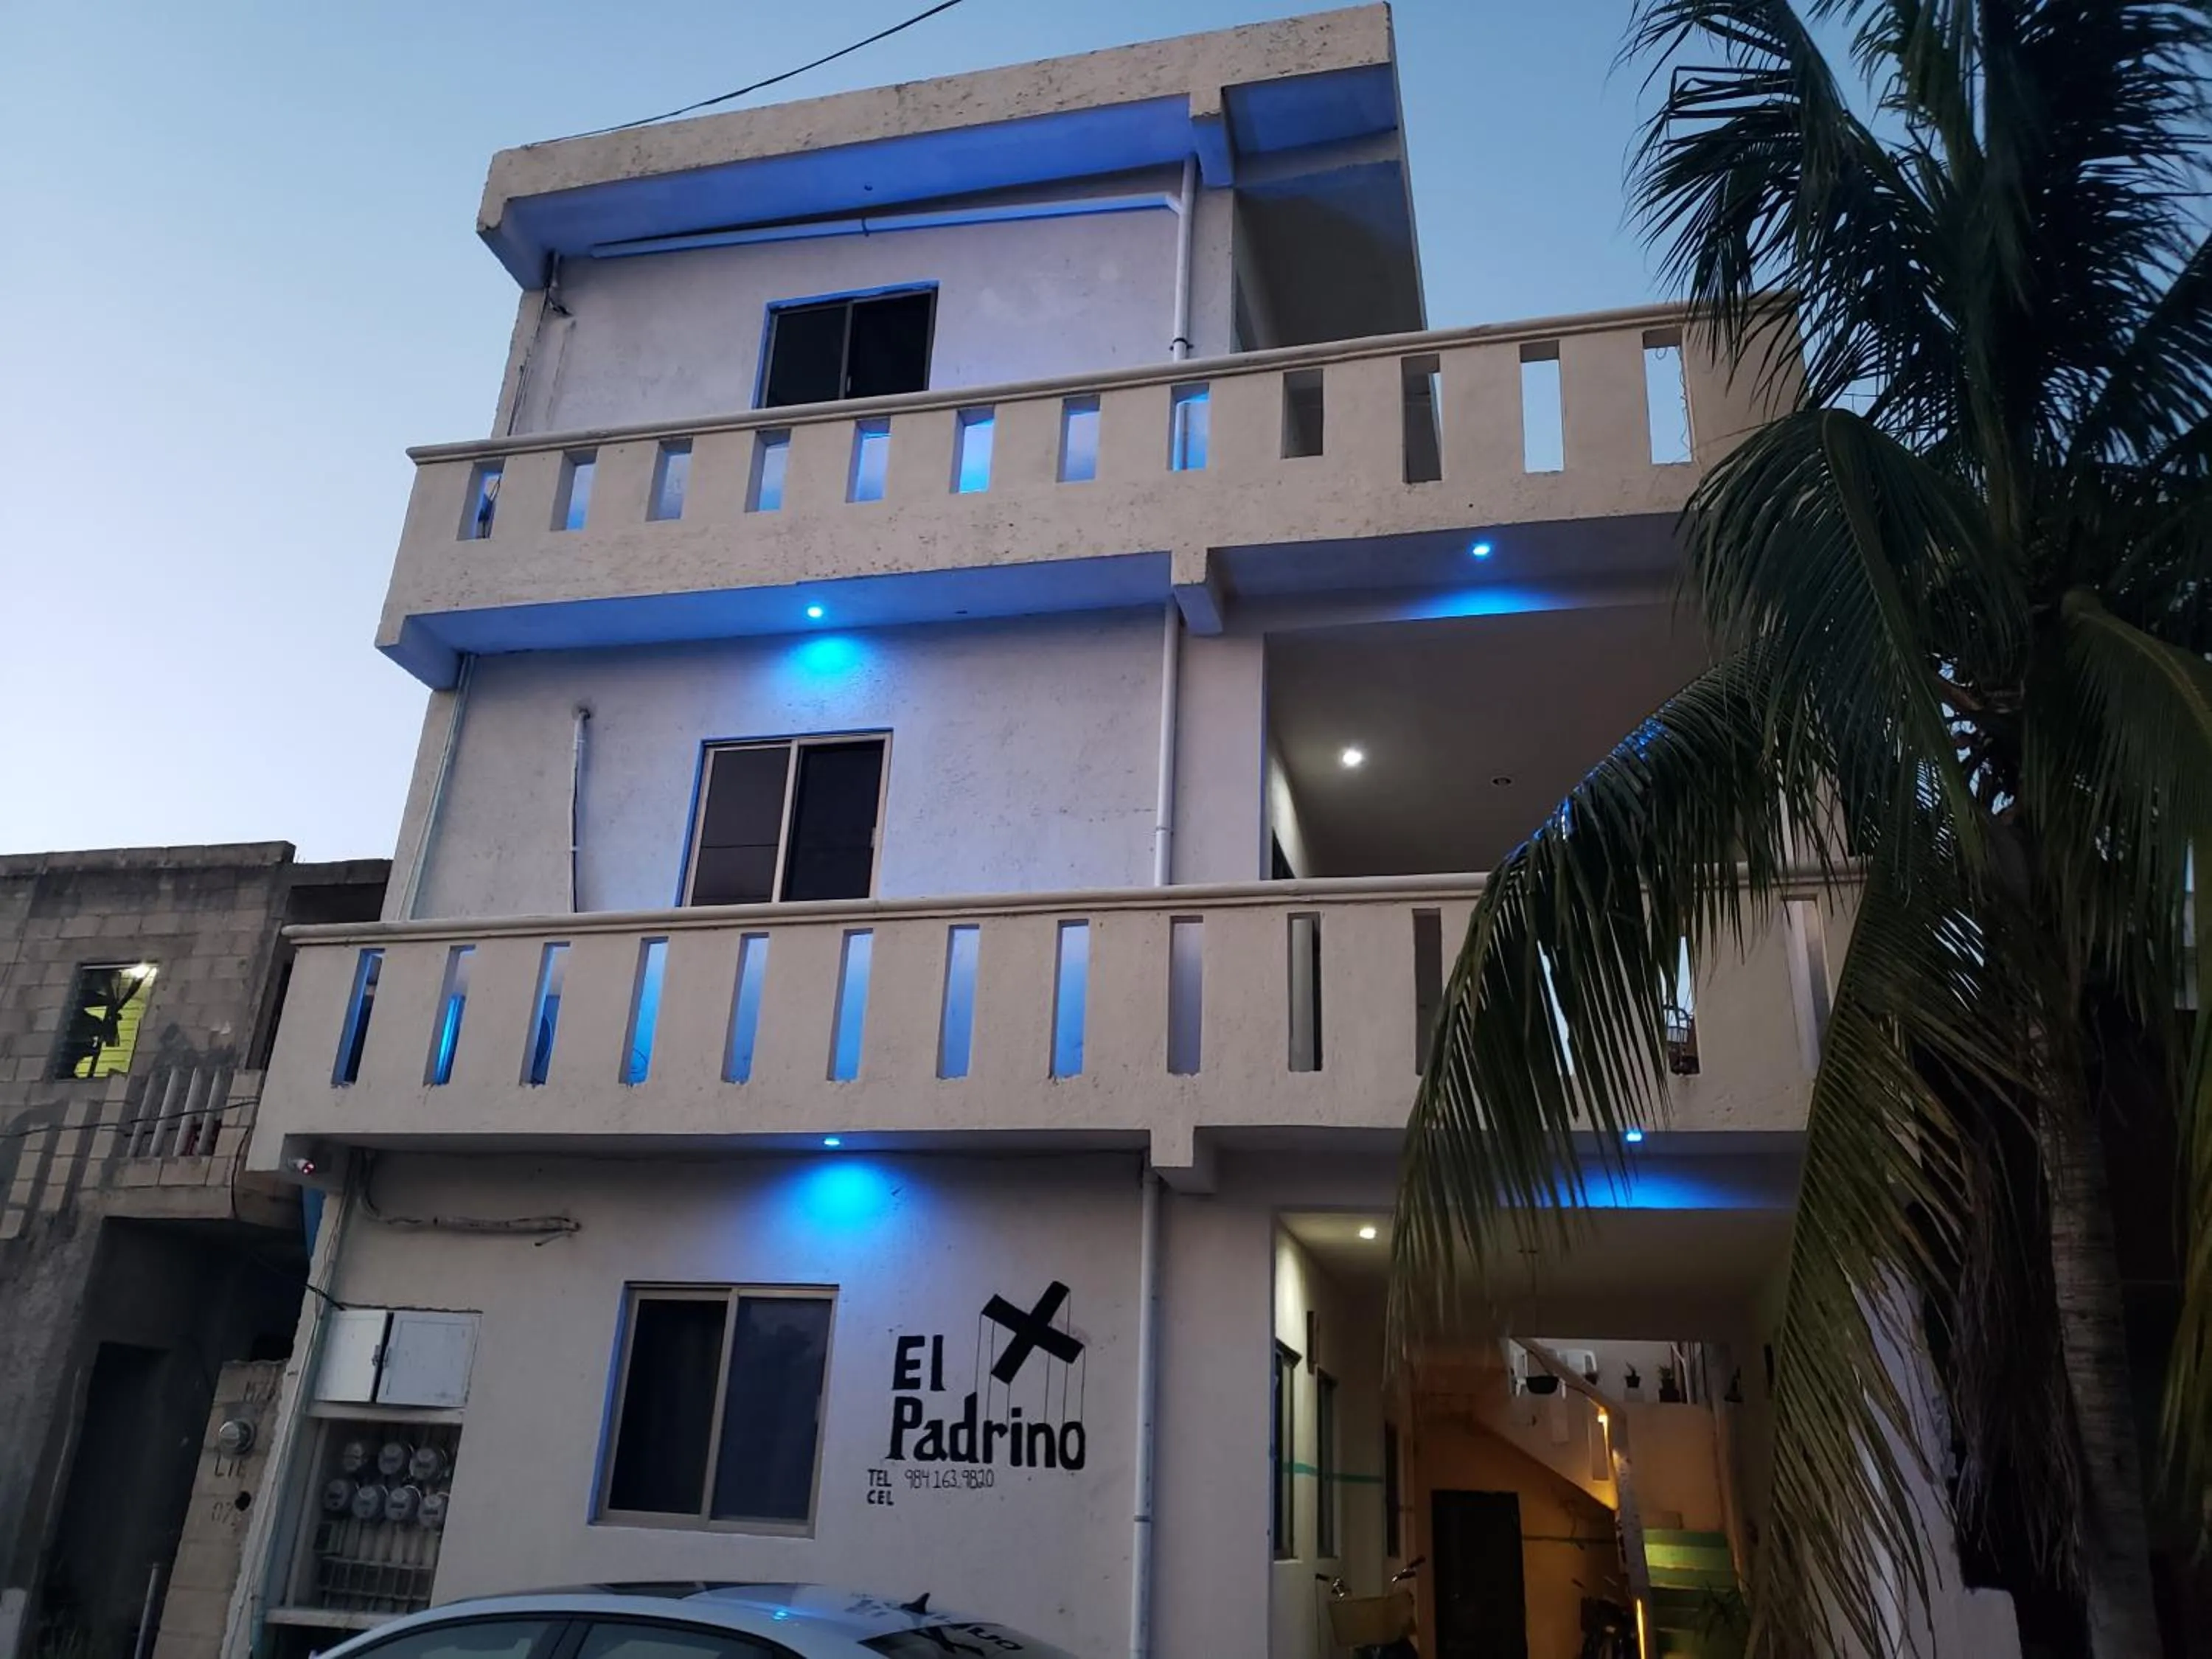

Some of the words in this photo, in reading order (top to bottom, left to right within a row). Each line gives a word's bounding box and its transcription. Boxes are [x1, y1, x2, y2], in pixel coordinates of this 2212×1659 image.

[892, 1335, 946, 1391] El
[885, 1392, 1085, 1471] Padrino
[868, 1469, 892, 1487] TEL
[866, 1489, 894, 1506] CEL
